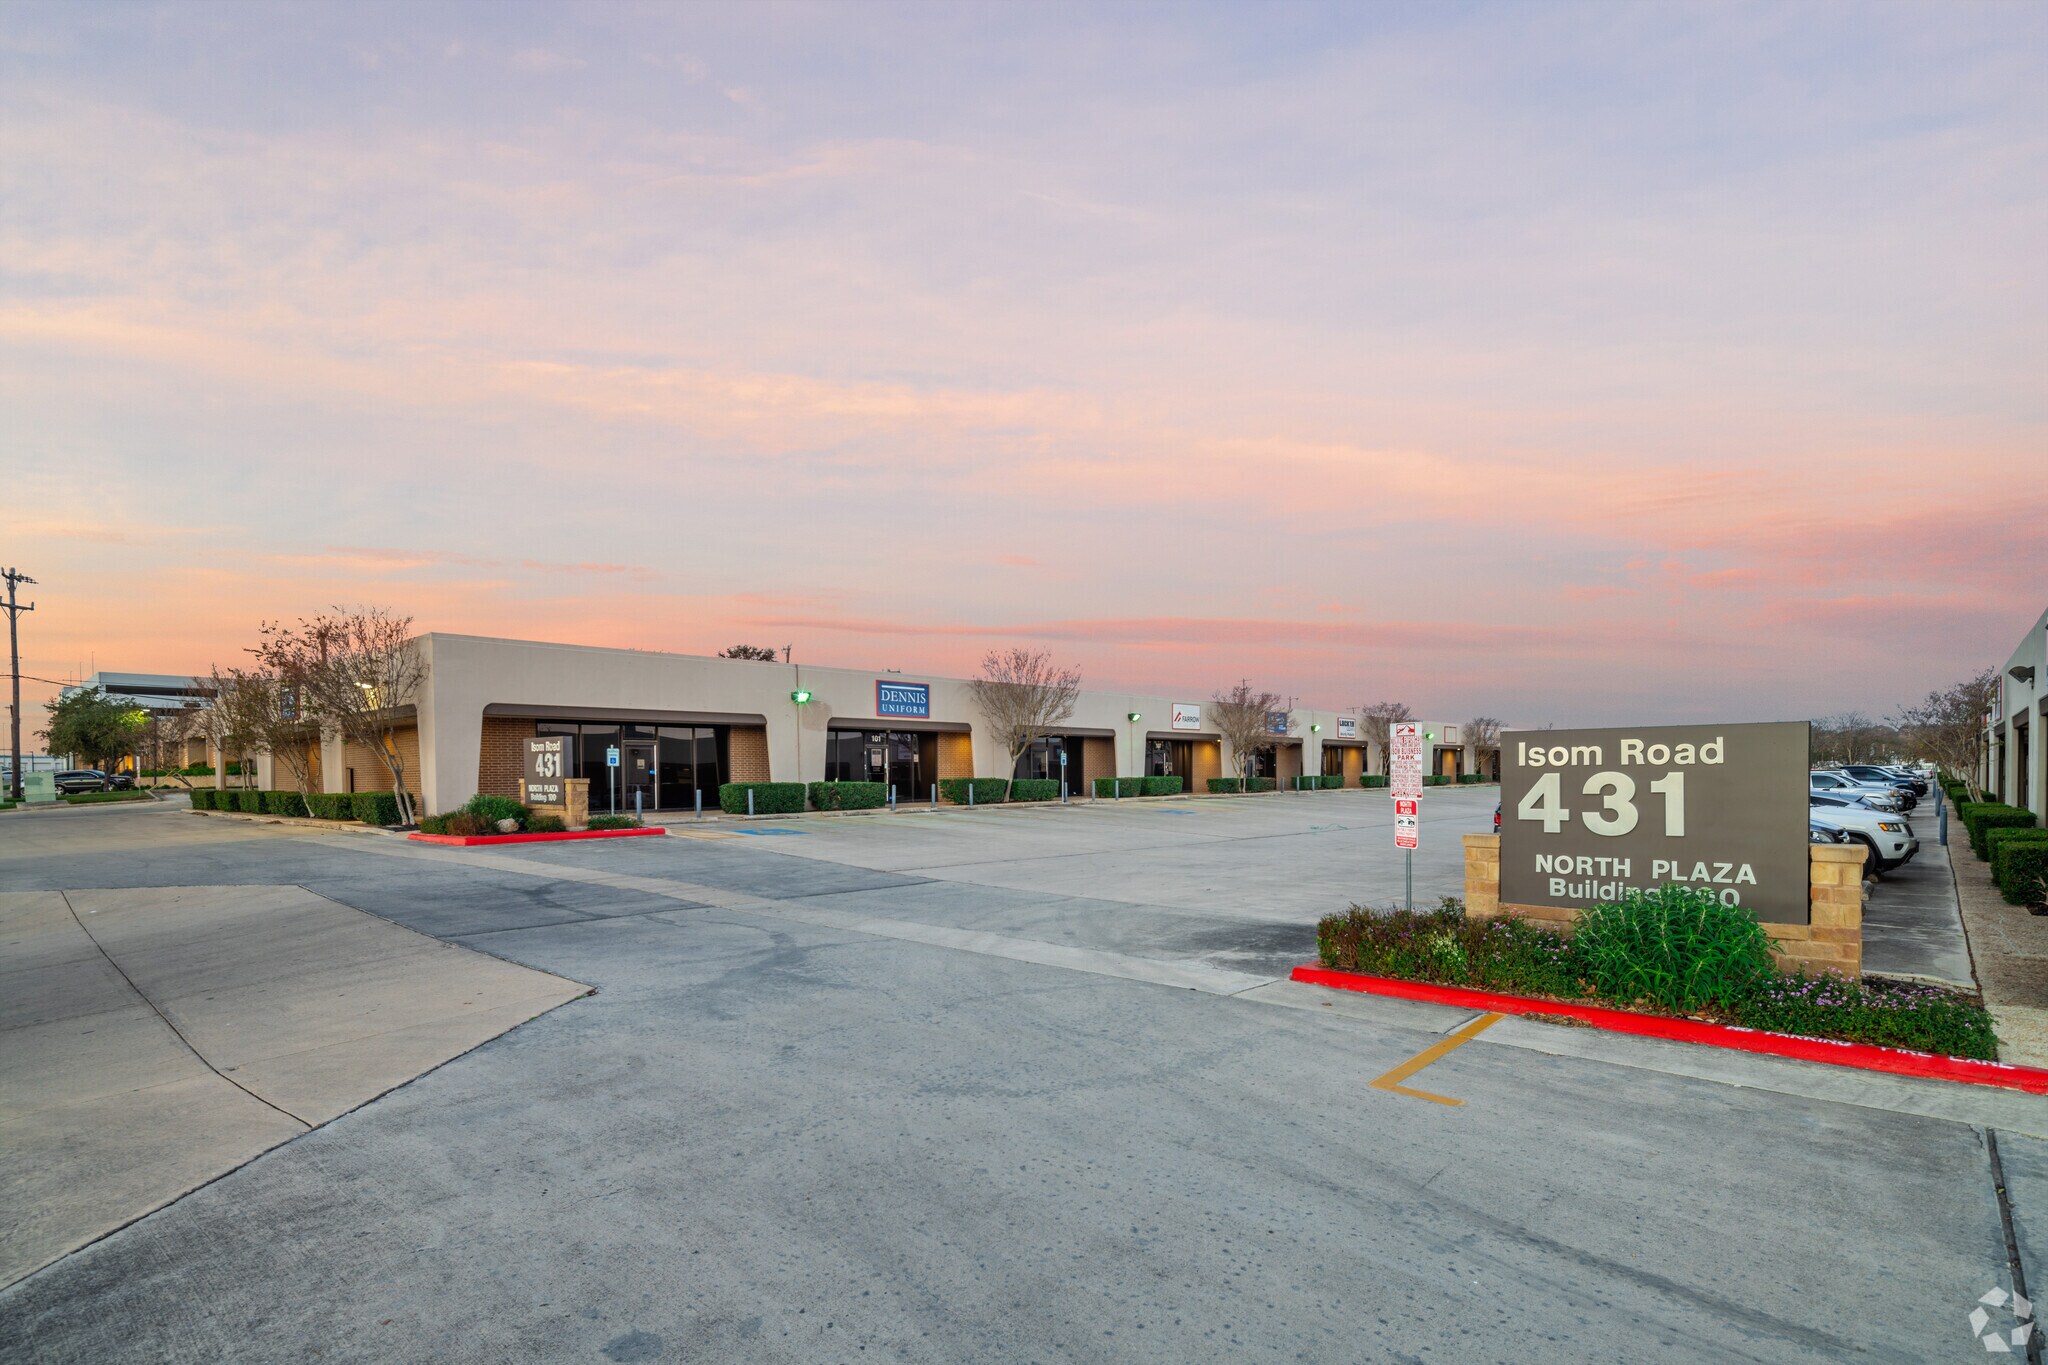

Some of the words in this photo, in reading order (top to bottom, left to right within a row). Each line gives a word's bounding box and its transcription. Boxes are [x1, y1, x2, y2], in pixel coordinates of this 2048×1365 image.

[881, 689, 926, 704] DENNIS
[882, 704, 925, 714] UNIFORM
[531, 742, 544, 752] Isom
[545, 741, 560, 752] Road
[871, 735, 881, 743] 101
[1518, 742, 1603, 767] Isom
[1620, 736, 1725, 766] Road
[535, 753, 561, 778] 431
[528, 784, 543, 792] NORTH
[544, 785, 559, 793] PLAZA
[1517, 771, 1686, 837] 431
[1535, 854, 1631, 878] NORTH
[1652, 860, 1757, 885] PLAZA
[1680, 885, 1741, 908] 00
